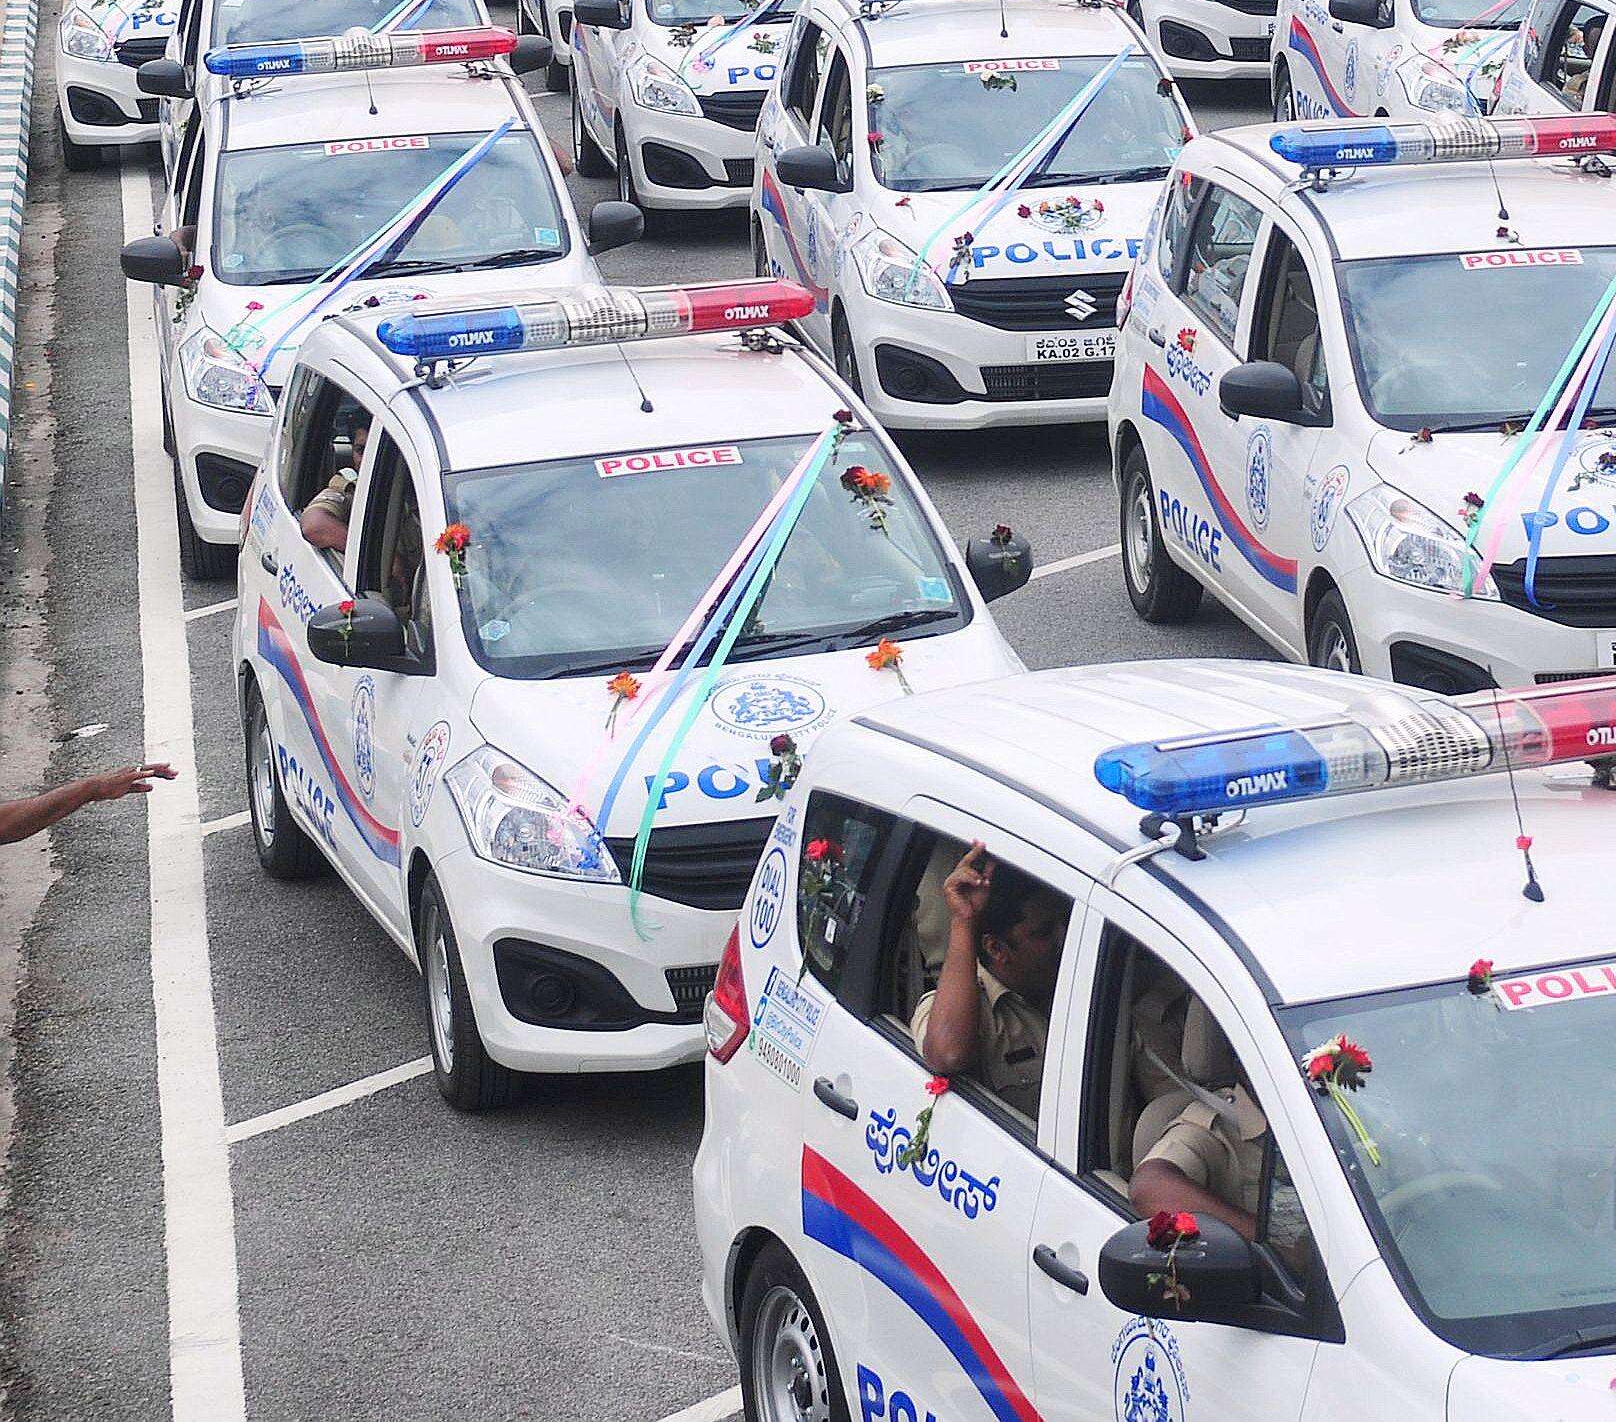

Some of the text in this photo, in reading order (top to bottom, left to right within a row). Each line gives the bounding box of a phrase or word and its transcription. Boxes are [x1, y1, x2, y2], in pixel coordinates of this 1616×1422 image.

[968, 61, 1055, 72] POLICE
[330, 138, 426, 154] POLICE
[1559, 137, 1597, 148] OTLMAX
[1336, 148, 1374, 160] OTLMAX
[972, 238, 1143, 269] POLICE
[1466, 251, 1579, 268] POLICE
[724, 306, 769, 319] OTLMAX
[449, 331, 495, 347] OTLMAX
[1037, 346, 1115, 360] KA.02 G.17
[602, 446, 734, 473] POLICE
[1159, 489, 1222, 572] POLICE
[1226, 771, 1288, 798] OTLMAX
[762, 864, 782, 899] DIAL
[755, 896, 776, 935] 100
